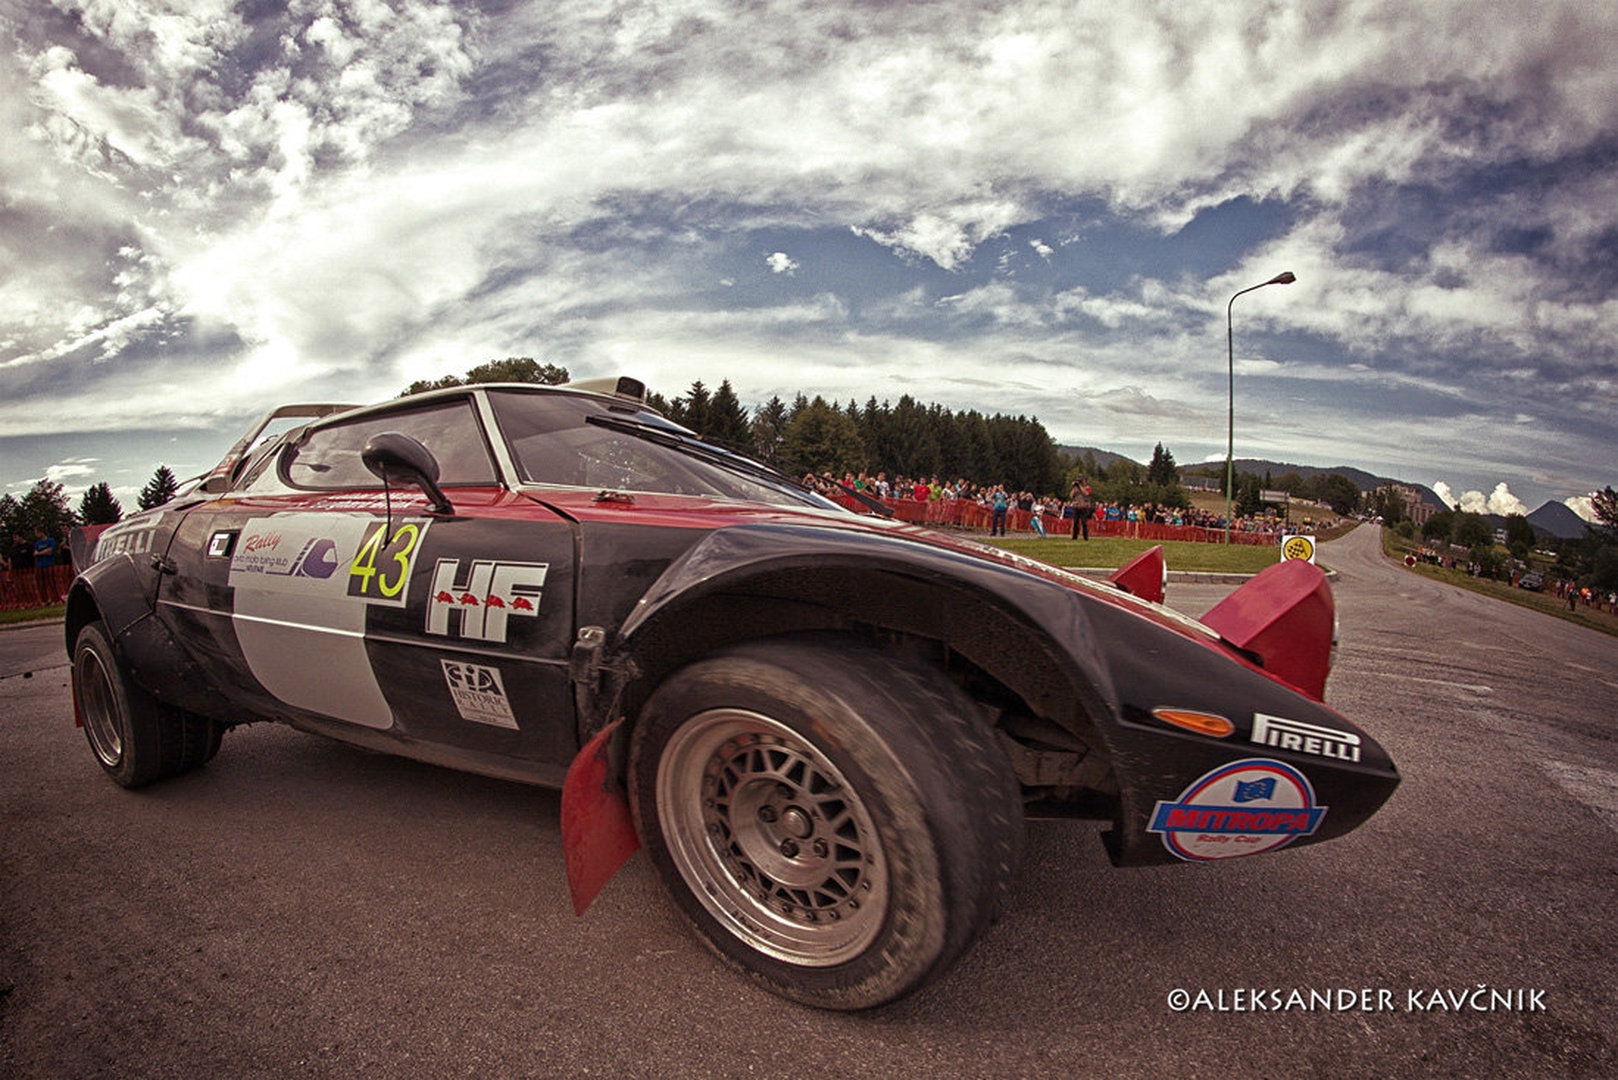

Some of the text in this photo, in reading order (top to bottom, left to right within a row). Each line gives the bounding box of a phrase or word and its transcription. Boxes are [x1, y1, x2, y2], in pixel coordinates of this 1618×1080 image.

[93, 511, 164, 563] PIRELLI
[243, 531, 282, 554] Rally
[350, 523, 419, 597] 43
[425, 557, 549, 643] HF
[1251, 713, 1361, 763] PIRELLI
[1165, 808, 1310, 832] MITROPA
